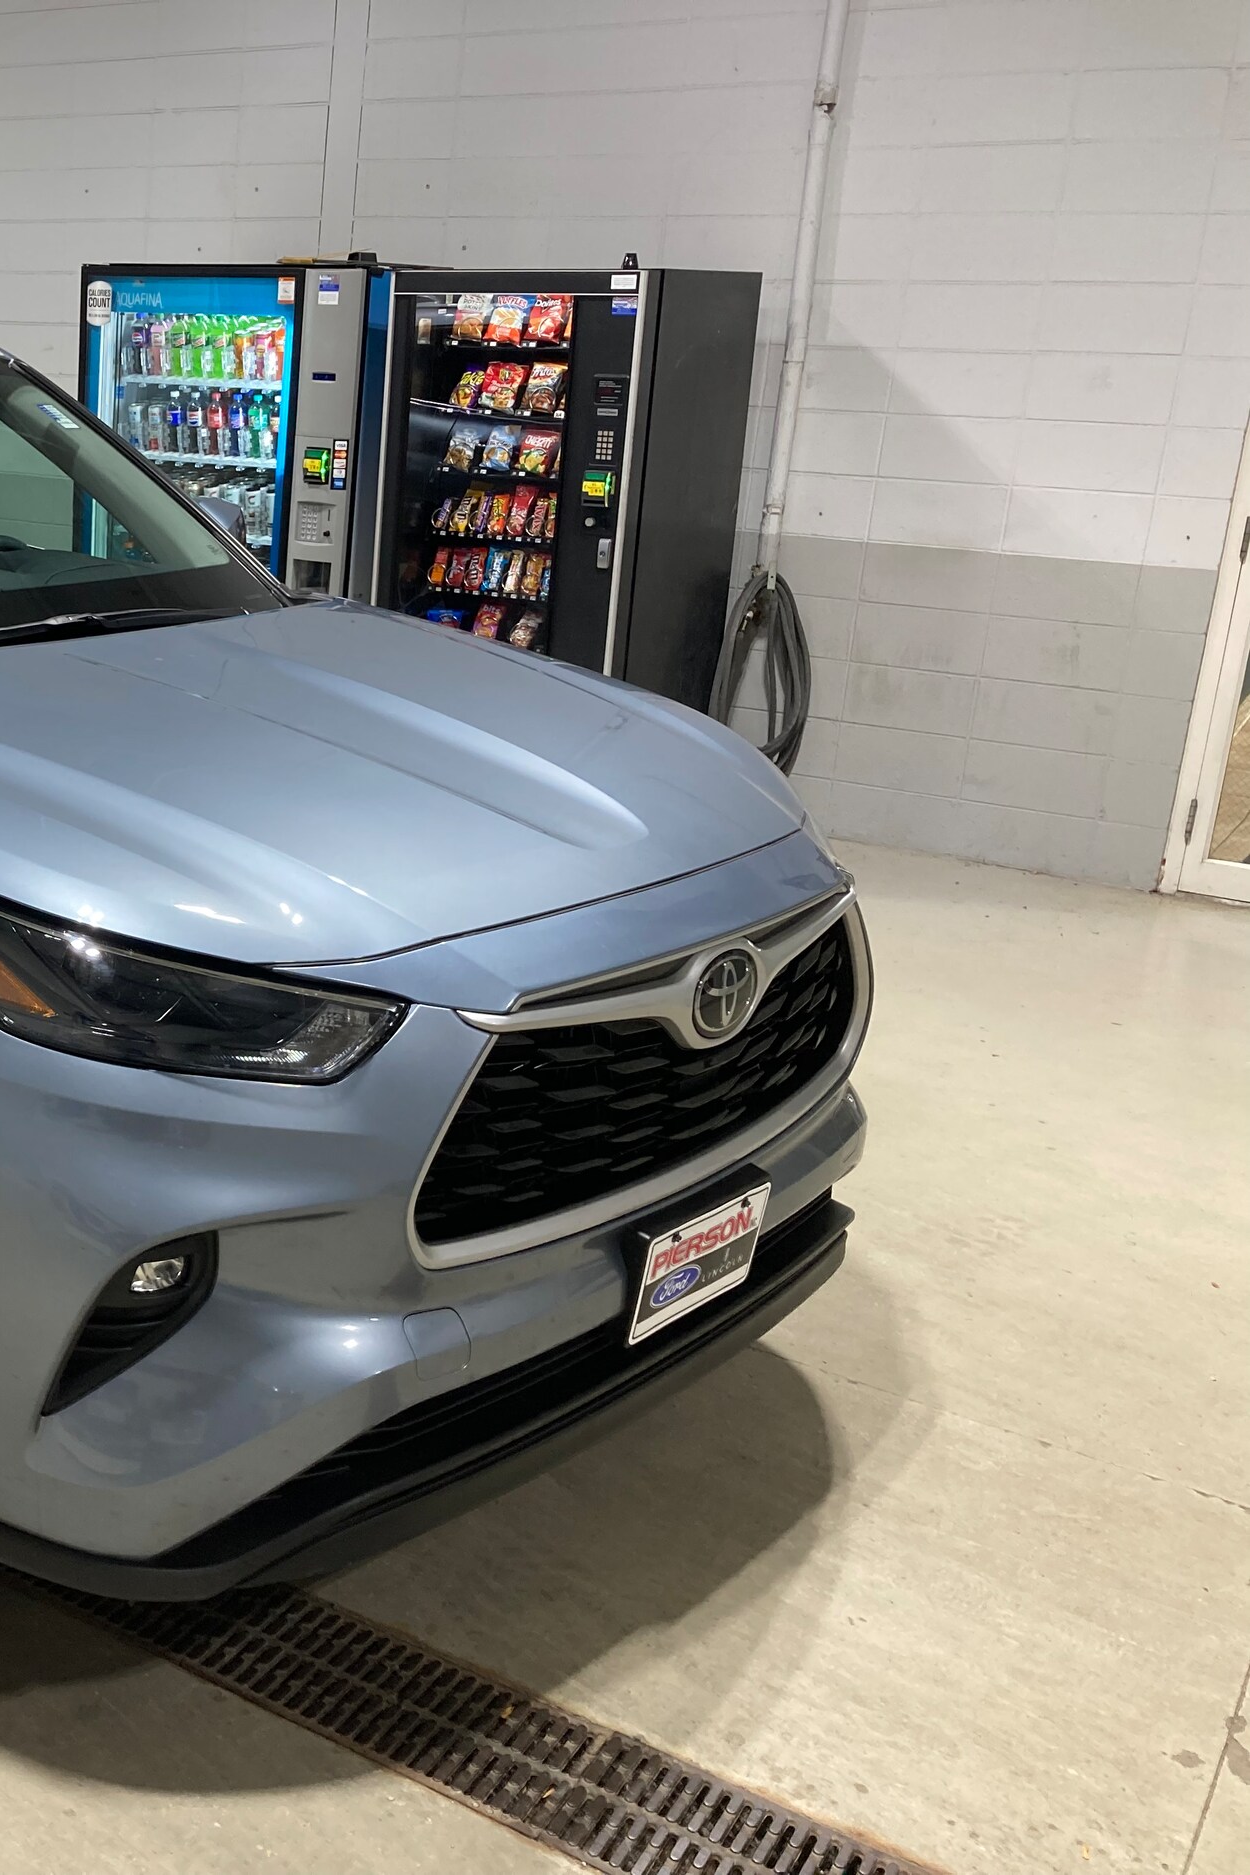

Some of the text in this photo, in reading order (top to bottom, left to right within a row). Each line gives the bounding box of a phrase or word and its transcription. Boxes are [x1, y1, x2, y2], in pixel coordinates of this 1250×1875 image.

[88, 288, 111, 297] CALORIES
[88, 297, 111, 308] COUNT
[115, 291, 164, 309] AQUAFINA
[650, 1206, 754, 1281] PIERSON
[701, 1254, 743, 1283] LINCOLN
[659, 1270, 692, 1301] Ford
